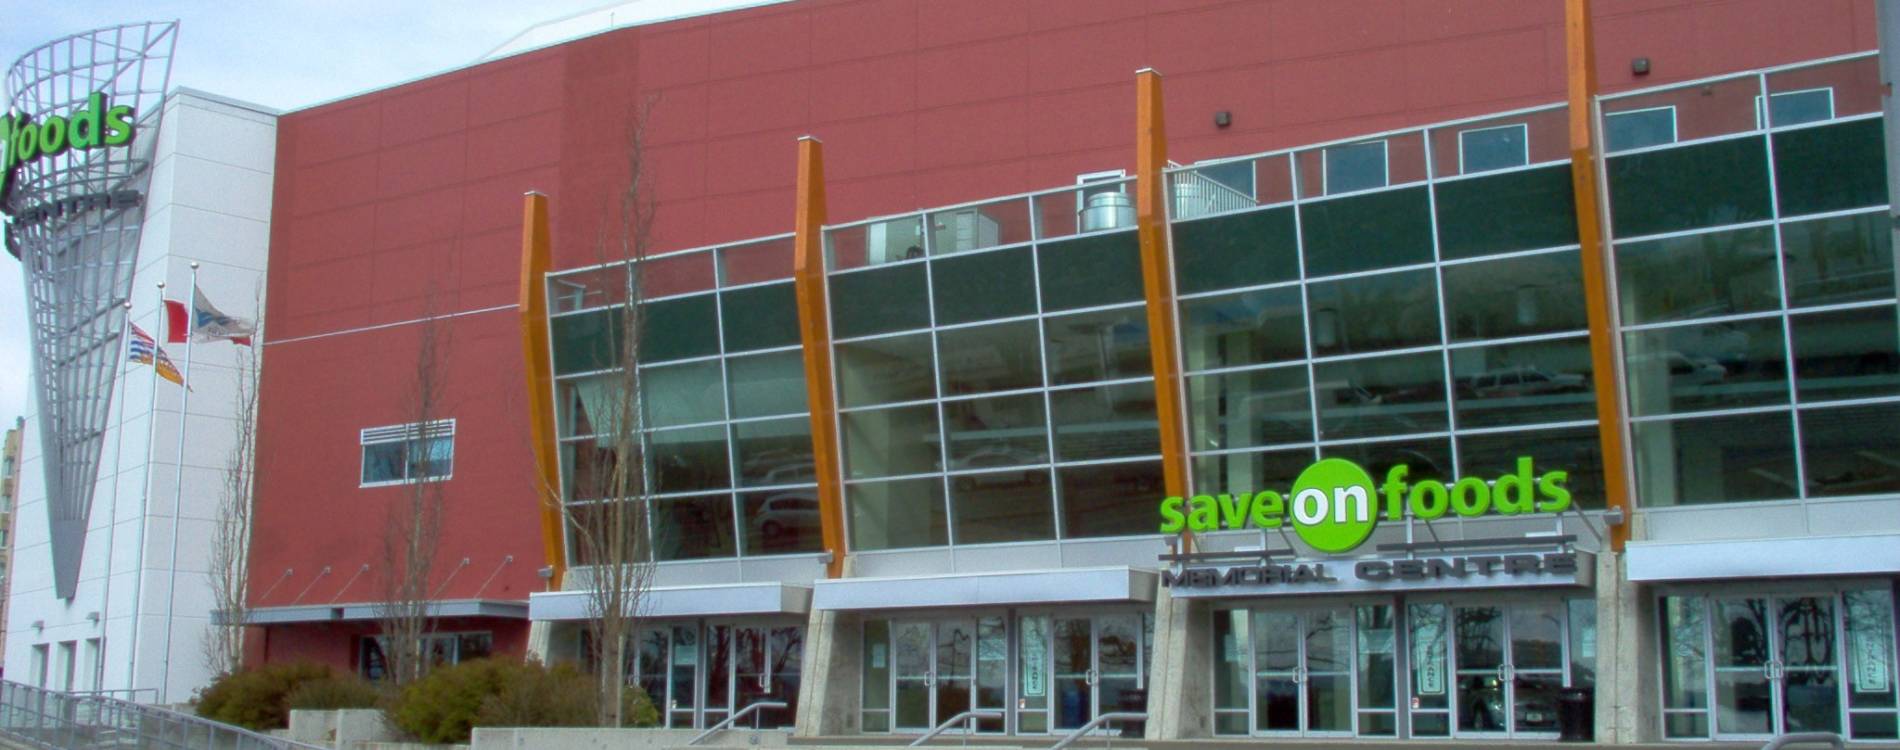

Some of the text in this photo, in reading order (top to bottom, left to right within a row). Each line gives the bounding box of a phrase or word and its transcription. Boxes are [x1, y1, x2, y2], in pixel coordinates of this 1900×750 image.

[9, 90, 134, 167] foods
[1159, 456, 1572, 534] save on foods
[1161, 552, 1578, 588] MEMORIAL CENTRE
